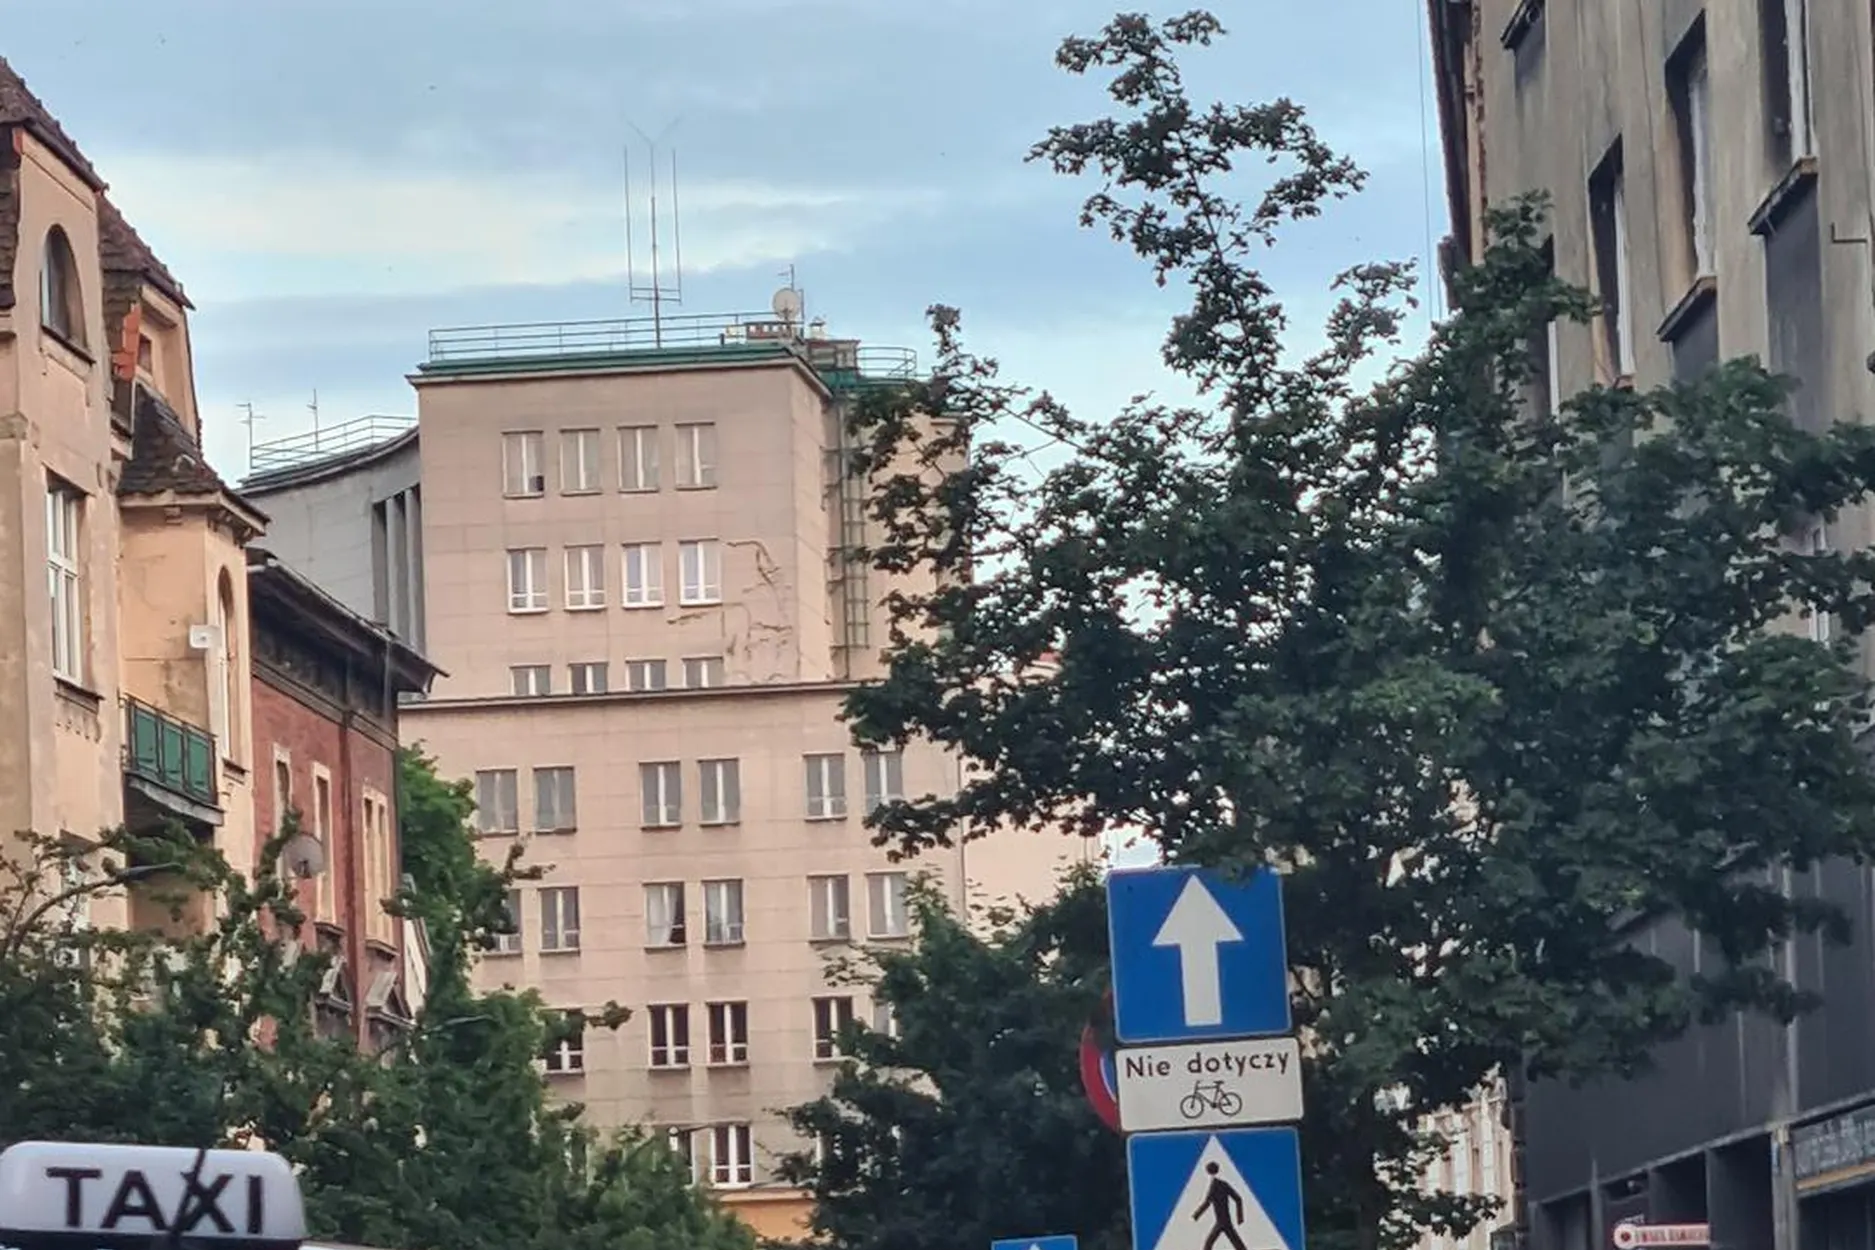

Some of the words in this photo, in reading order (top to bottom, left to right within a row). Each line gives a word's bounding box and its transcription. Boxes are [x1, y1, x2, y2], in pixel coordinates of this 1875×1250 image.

[1126, 1055, 1170, 1079] Nie
[1187, 1051, 1289, 1078] dotyczy
[46, 1166, 264, 1235] TAXI
